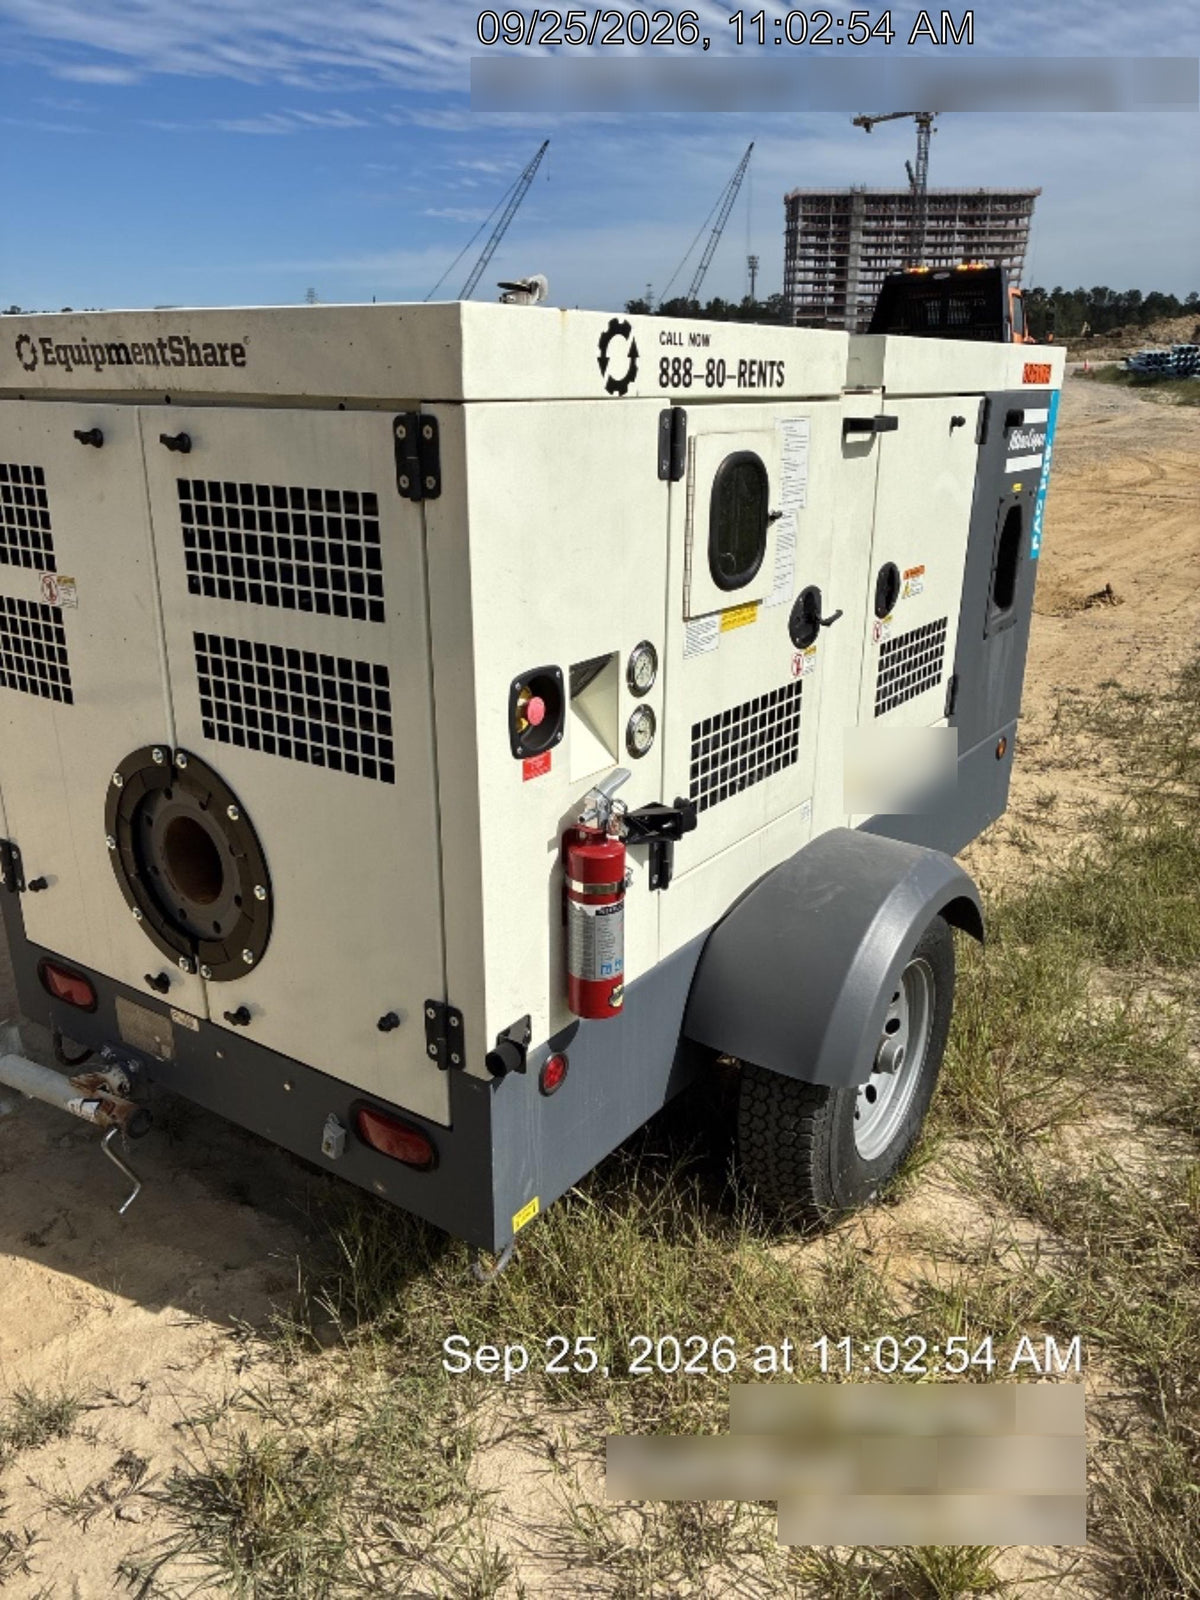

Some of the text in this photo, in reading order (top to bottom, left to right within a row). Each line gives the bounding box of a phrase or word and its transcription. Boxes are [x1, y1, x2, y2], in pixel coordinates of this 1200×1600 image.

[659, 331, 711, 347] CALL NOW
[659, 356, 785, 388] 888-80-RENTS
